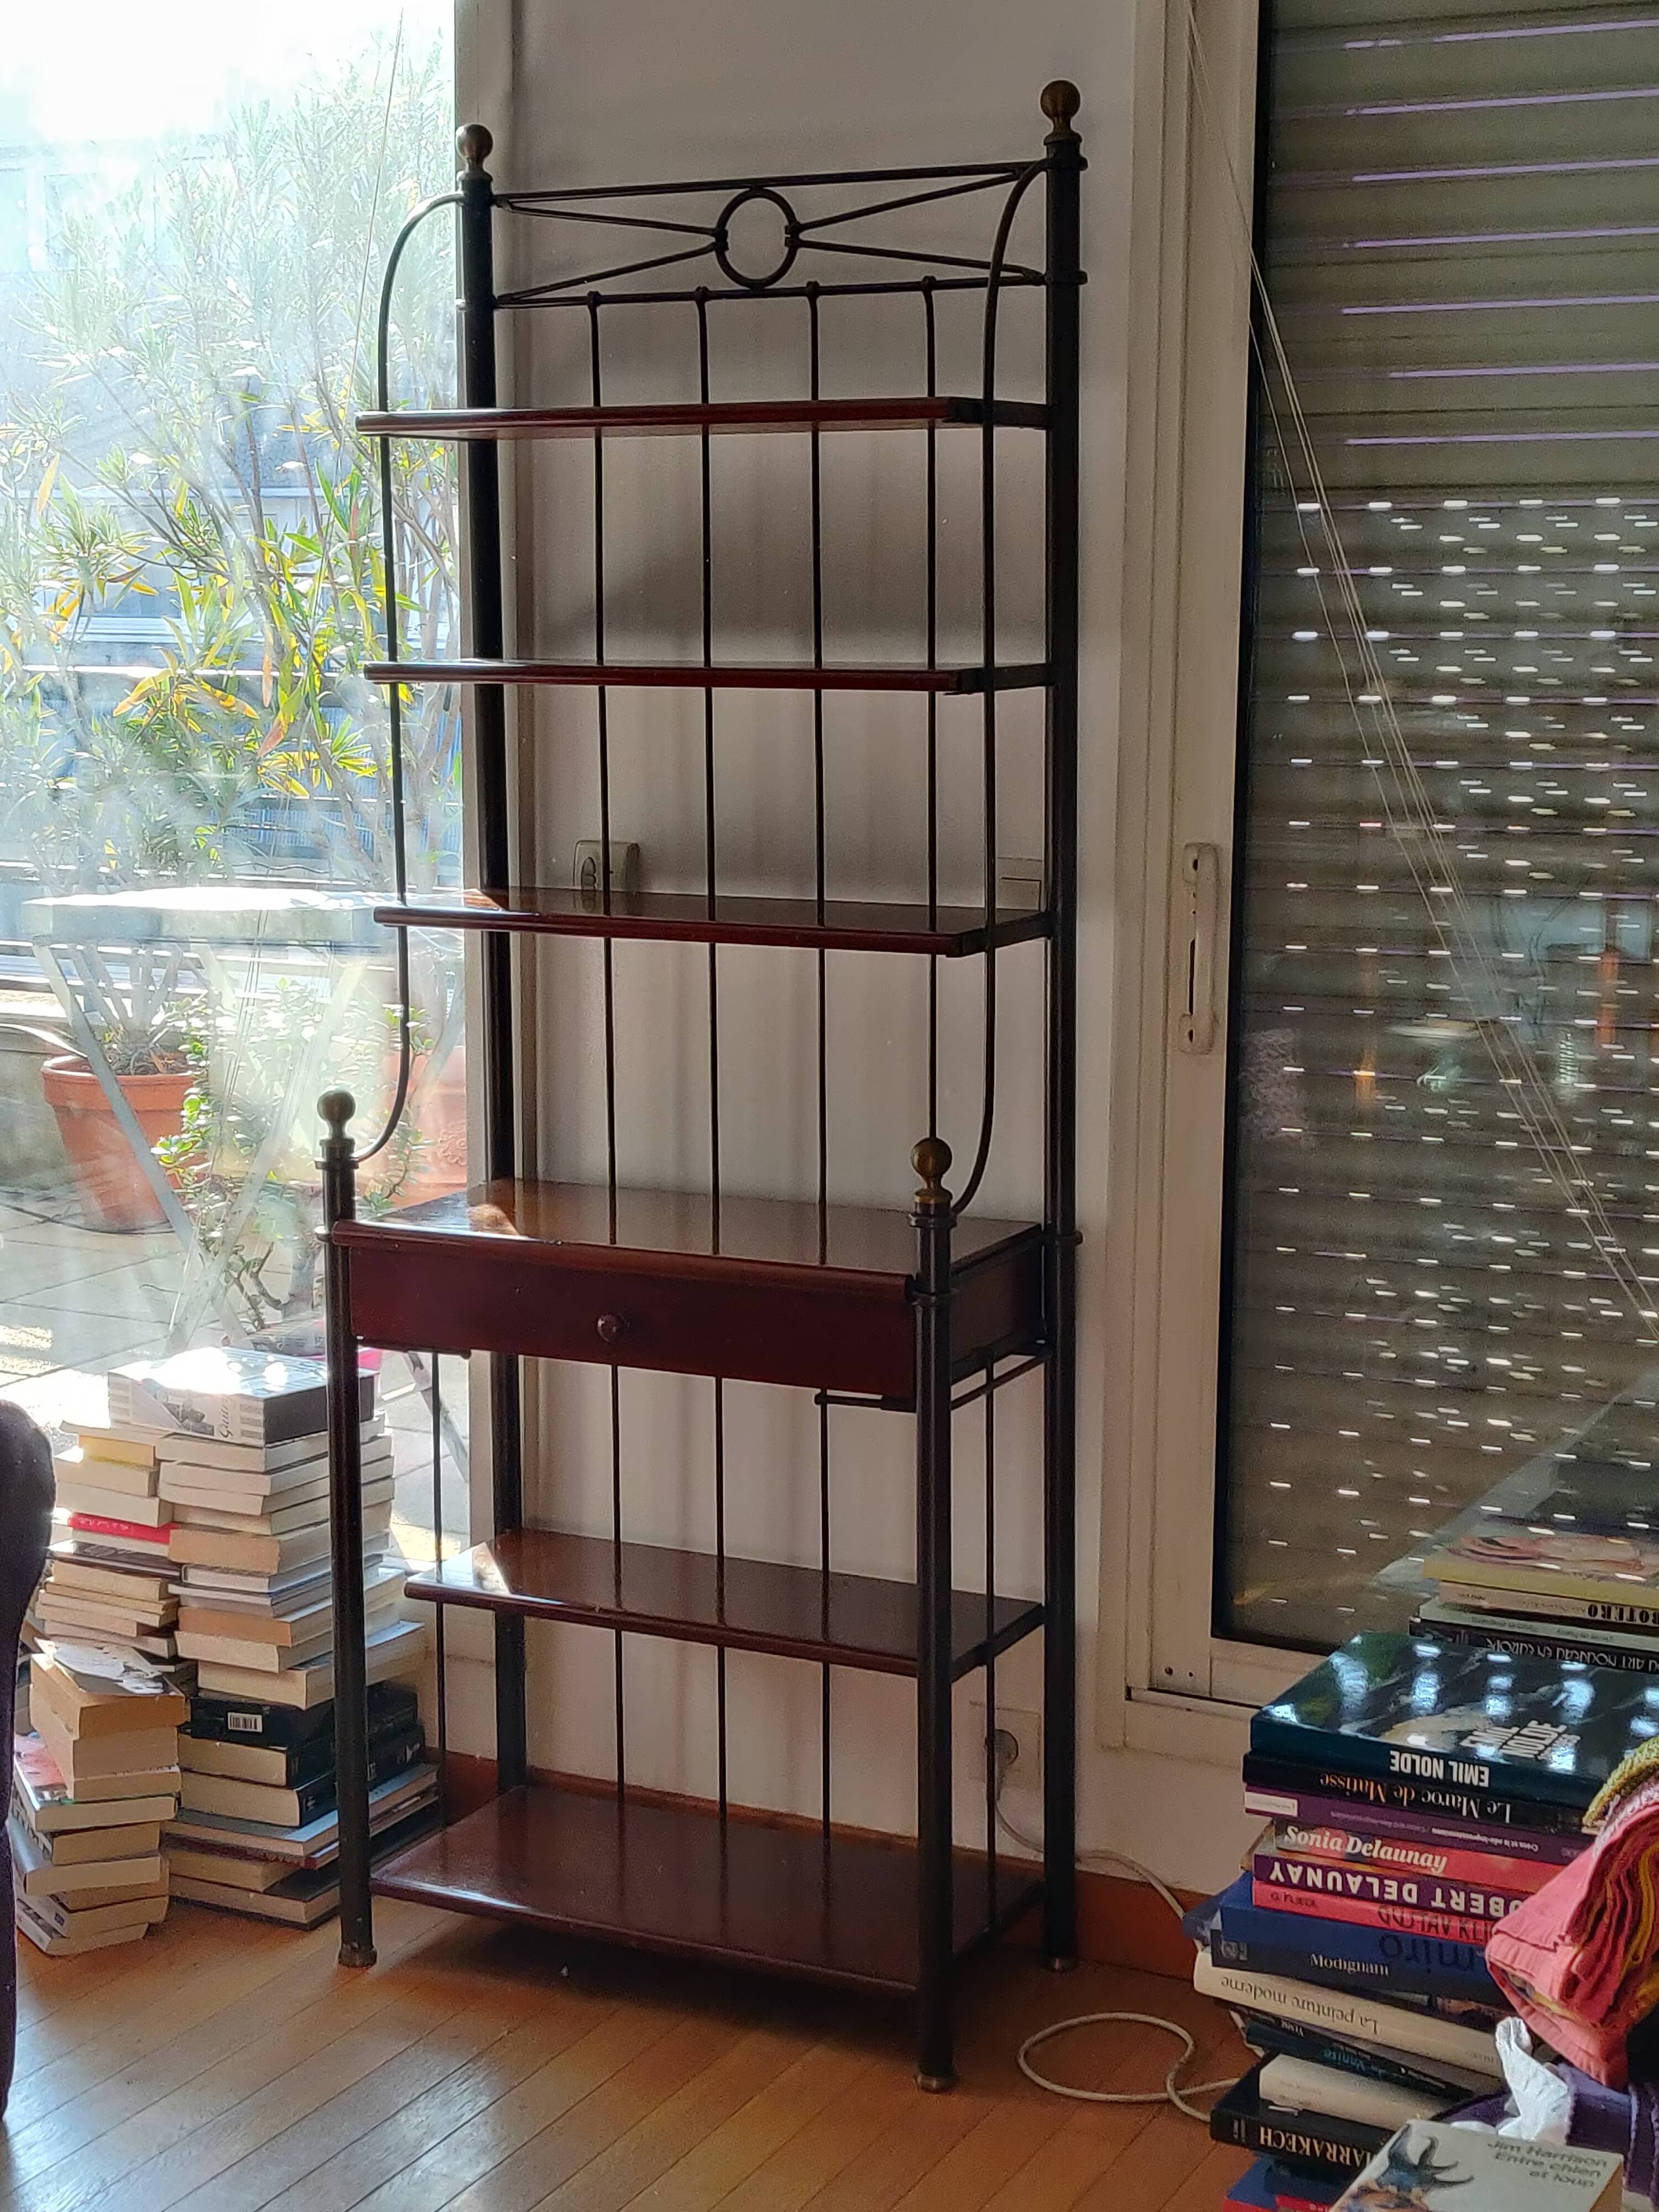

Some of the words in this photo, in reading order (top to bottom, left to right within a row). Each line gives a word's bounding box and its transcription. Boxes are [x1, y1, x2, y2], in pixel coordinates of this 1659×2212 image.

[1588, 1604, 1659, 1627] BOTERO
[1486, 1637, 1535, 1655] EUROPE
[1556, 1647, 1617, 1666] NOUVEAU
[1622, 1655, 1645, 1670] ART
[1499, 1720, 1567, 1758] NOLDE
[1390, 1750, 1444, 1780] NOLDE
[1448, 1760, 1489, 1787] EMIL
[1320, 1772, 1387, 1803] Matisse
[1394, 1786, 1415, 1807] de
[1422, 1791, 1480, 1818] Maroc
[1486, 1800, 1512, 1823] Le
[1284, 1825, 1345, 1850] Sonia
[1345, 1835, 1448, 1875] Delaunay
[1269, 1860, 1418, 1904] DELAUNAY
[1310, 1953, 1390, 1976] Modigliani
[1220, 1976, 1287, 2005] moderne
[1291, 1996, 1355, 2023] peinture
[1360, 2016, 1381, 2034] La
[1487, 2141, 1521, 2152] Jim
[1526, 2146, 1607, 2168] Harrison
[1494, 2152, 1545, 2166] Entre
[1550, 2163, 1601, 2178] chien
[1553, 2174, 1595, 2188] loup
